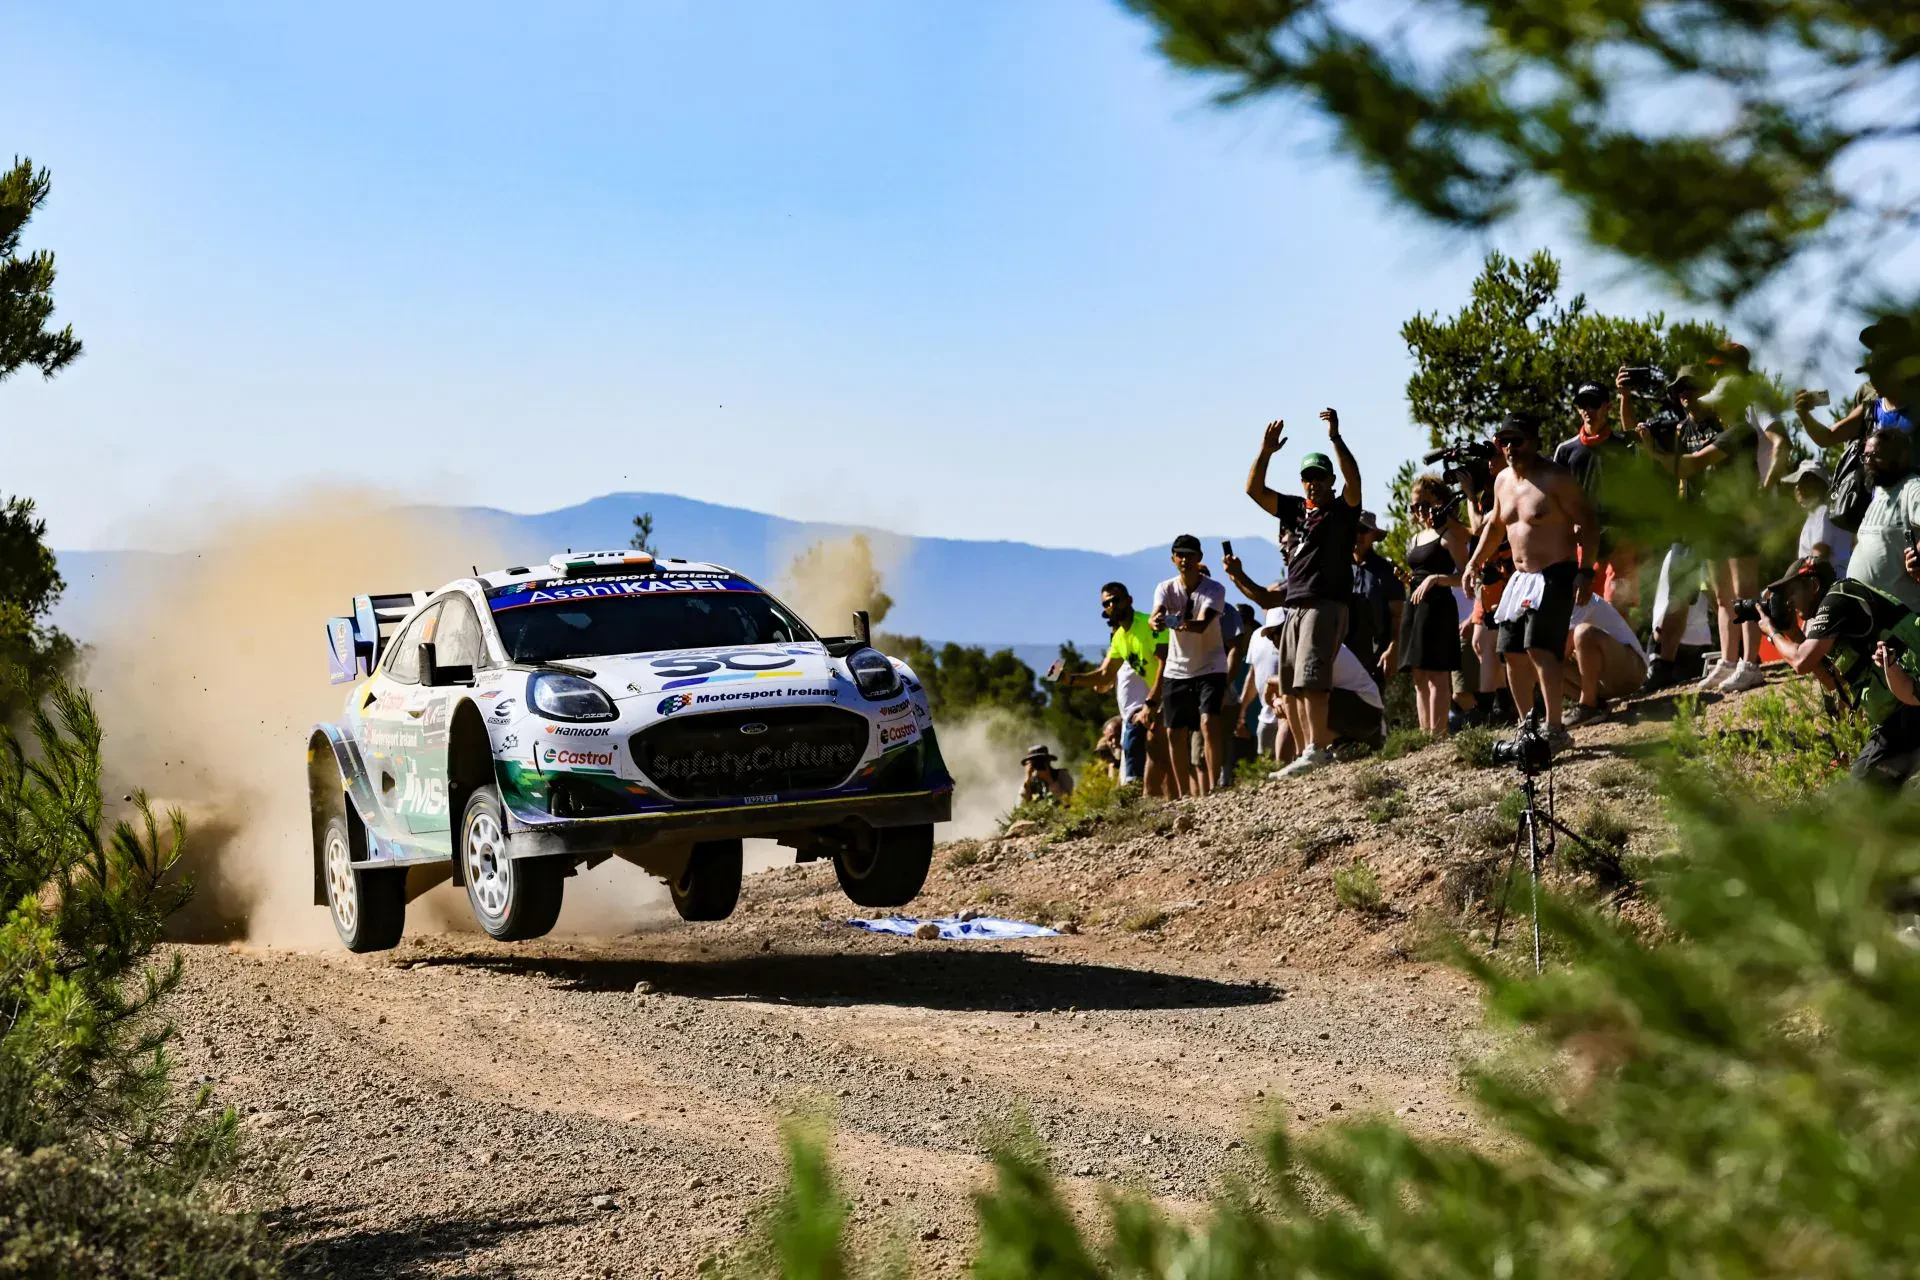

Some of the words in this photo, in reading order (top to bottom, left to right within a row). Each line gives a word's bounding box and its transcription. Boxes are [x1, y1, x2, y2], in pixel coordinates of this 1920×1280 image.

[546, 573, 657, 588] Motorsport
[663, 571, 730, 581] Ireland
[650, 651, 796, 678] SC
[696, 689, 782, 704] Motorsport
[787, 688, 839, 698] Ireland
[889, 721, 917, 741] Castrol
[557, 750, 613, 766] Castrol
